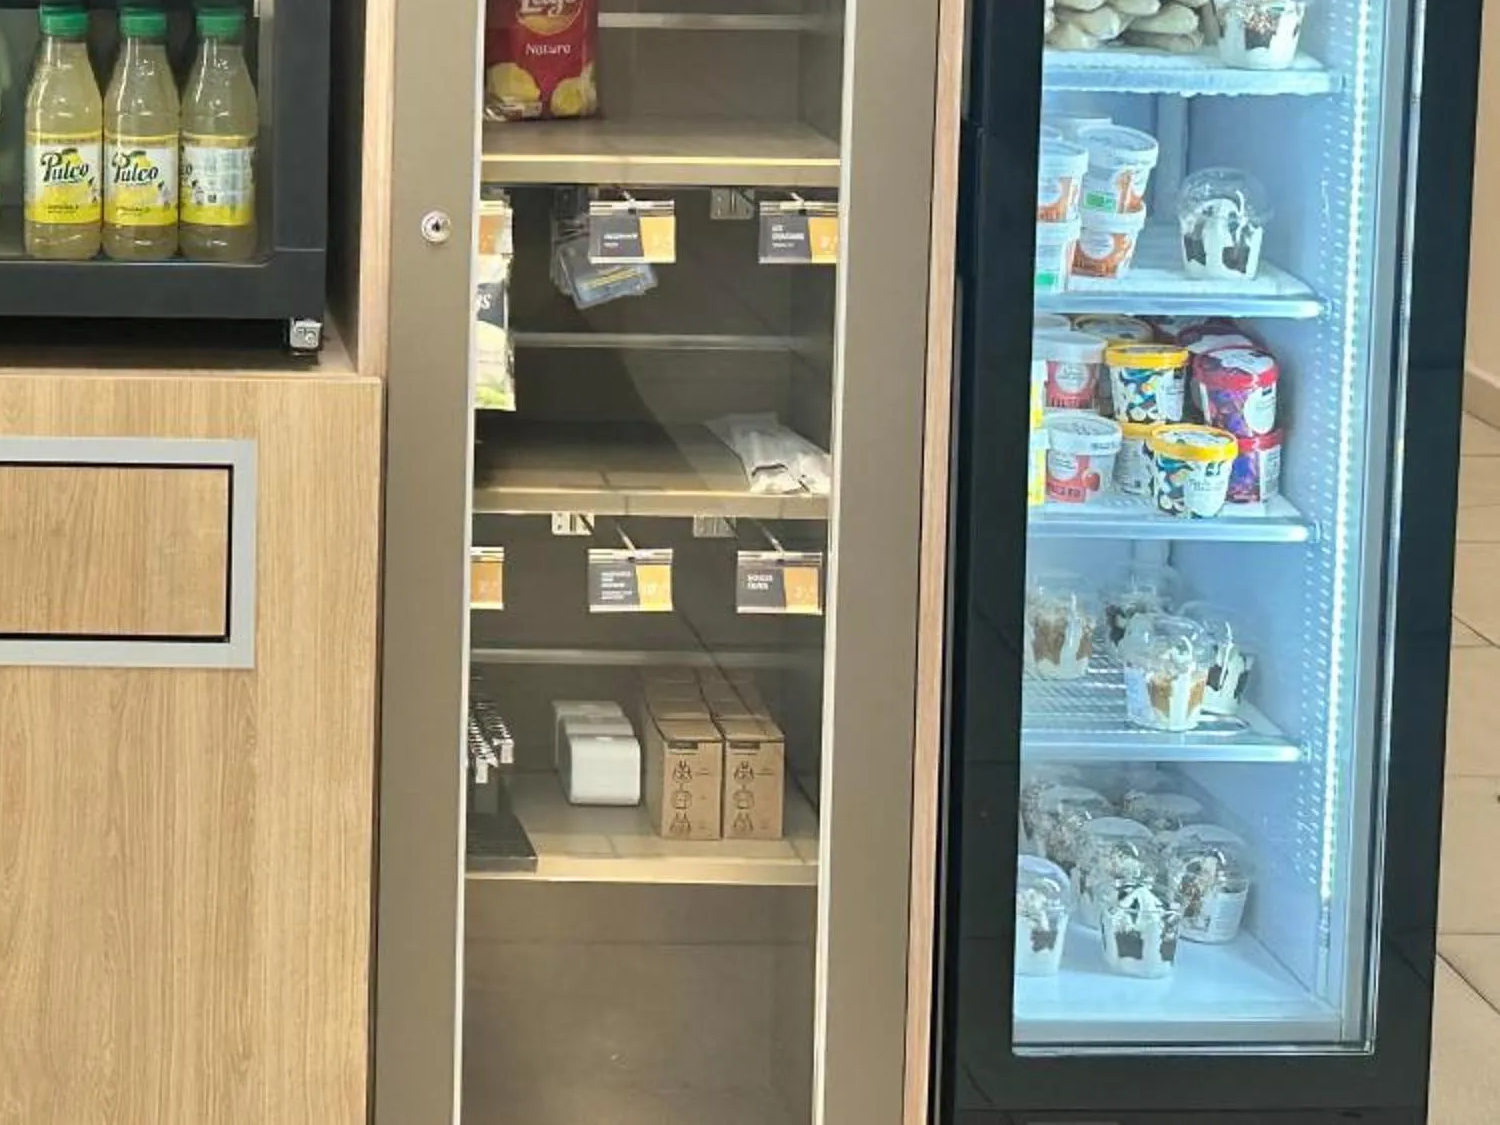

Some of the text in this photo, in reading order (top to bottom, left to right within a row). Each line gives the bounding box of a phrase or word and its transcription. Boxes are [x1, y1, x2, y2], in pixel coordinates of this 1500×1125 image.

[525, 40, 571, 56] Nature
[40, 152, 90, 183] Pulco
[111, 151, 159, 184] Pulco
